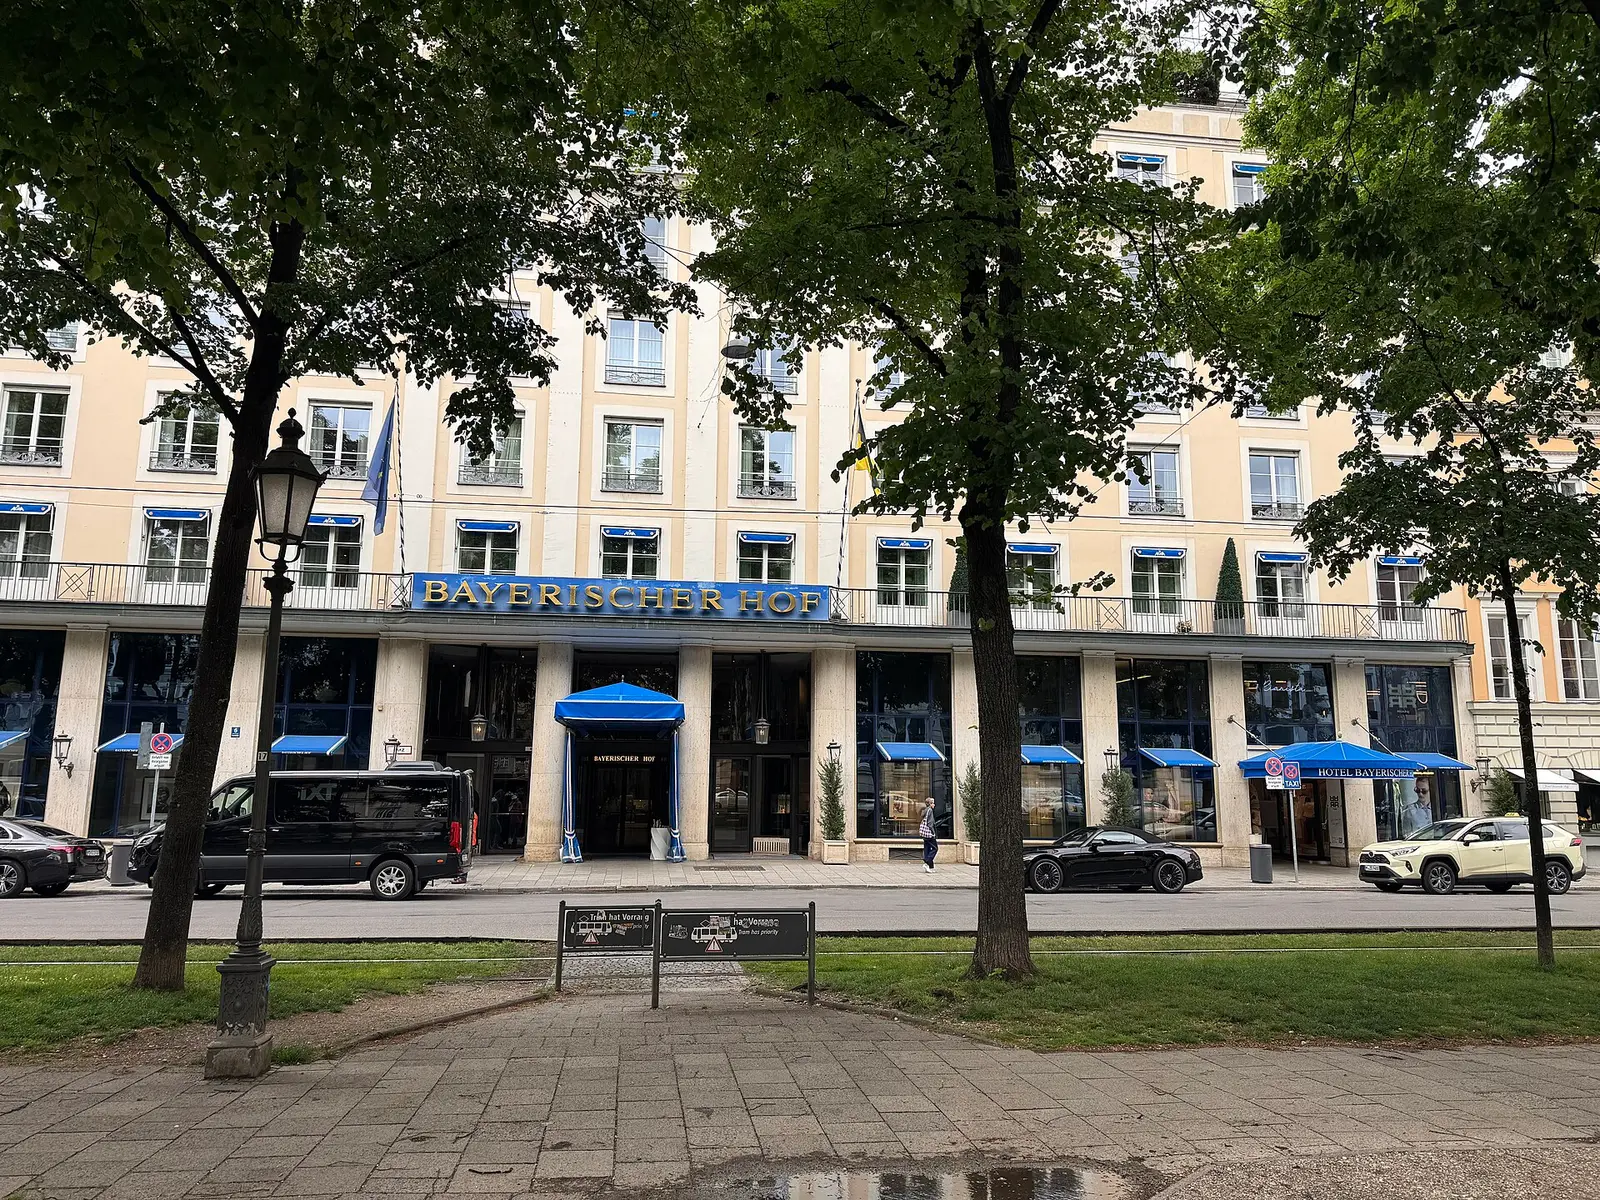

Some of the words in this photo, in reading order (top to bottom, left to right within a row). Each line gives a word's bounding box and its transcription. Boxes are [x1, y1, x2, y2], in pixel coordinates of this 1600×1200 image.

[422, 580, 724, 610] BAYERISCHER
[737, 590, 822, 613] HOF
[258, 752, 267, 760] 17
[1318, 768, 1353, 777] HOTEL
[608, 913, 620, 921] hat
[760, 928, 779, 936] priority
